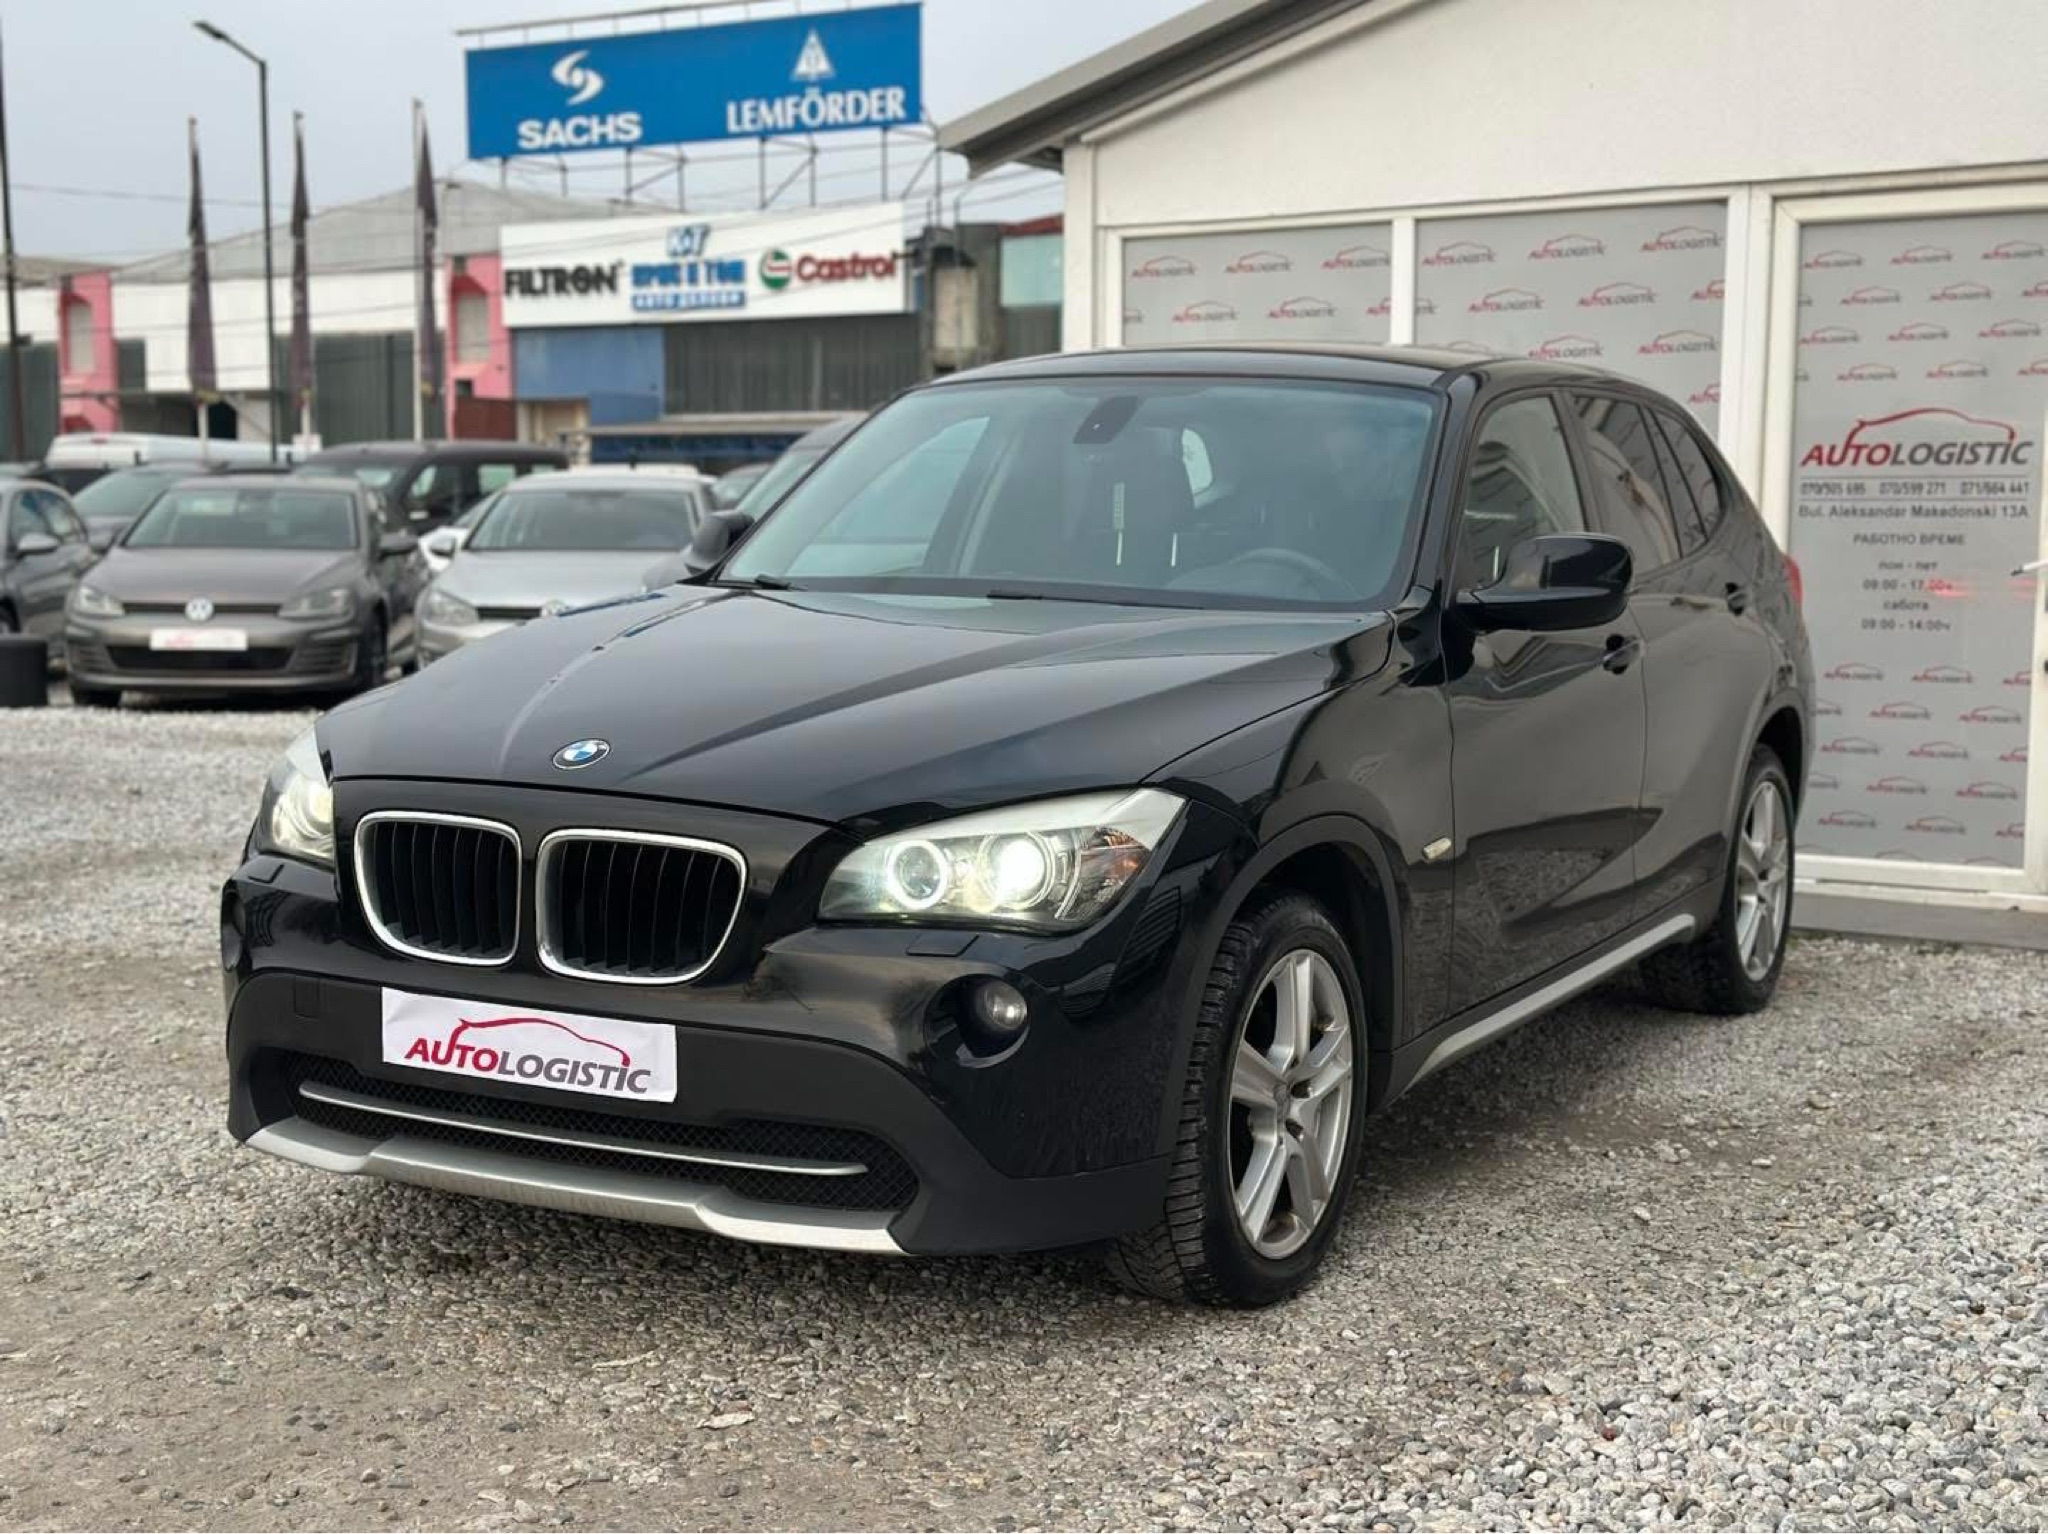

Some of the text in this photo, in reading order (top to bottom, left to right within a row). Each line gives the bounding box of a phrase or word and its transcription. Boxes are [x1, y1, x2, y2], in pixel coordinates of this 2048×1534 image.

[727, 85, 906, 133] LEMFÖRDER
[517, 112, 642, 150] SACHS
[504, 264, 618, 296] FILTRON
[797, 253, 896, 282] Castrol
[1801, 440, 2034, 467] AUTOLOGISTIC
[1829, 504, 1907, 518] Aleksandar
[1911, 504, 1997, 518] Makedonski
[2002, 505, 2029, 518] 13A
[1853, 533, 1966, 545] РАБОТНО ВРЕМЕ
[404, 1037, 652, 1094] AUTOLOGISTIC
